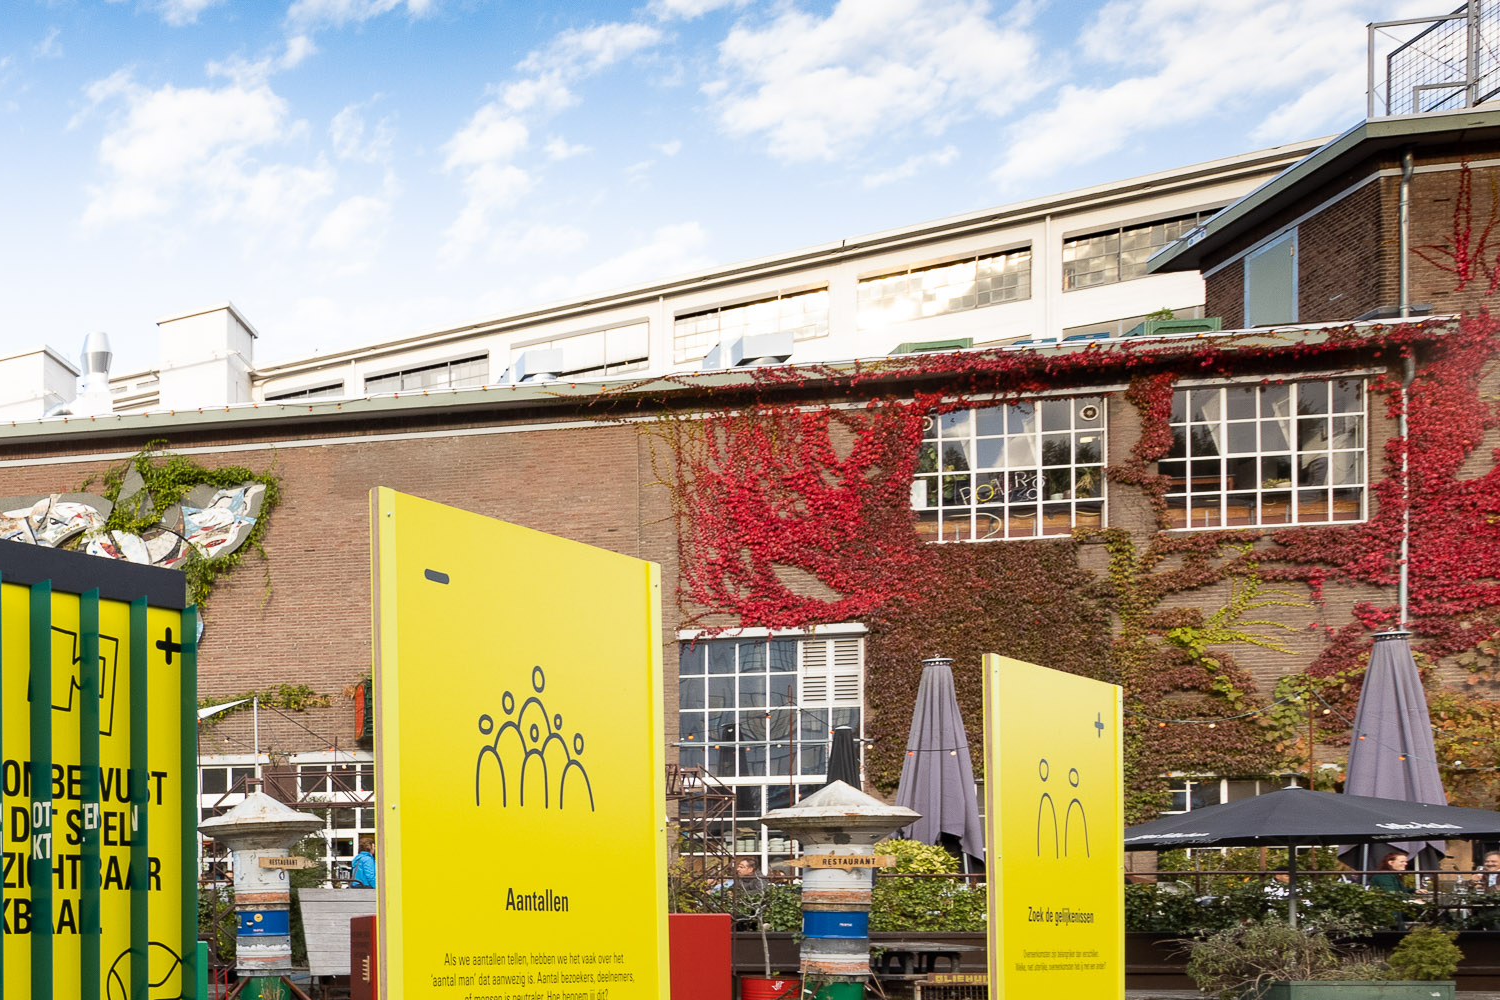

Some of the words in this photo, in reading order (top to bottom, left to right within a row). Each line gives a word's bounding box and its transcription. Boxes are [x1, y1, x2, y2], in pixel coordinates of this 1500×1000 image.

[505, 887, 568, 912] Aantallen
[443, 953, 456, 966] Als
[457, 955, 470, 965] we
[472, 952, 505, 965] aantallen
[506, 952, 528, 966] tellen,
[529, 952, 555, 965] hebben
[556, 955, 567, 964] we
[569, 952, 580, 964] het
[581, 951, 596, 964] vaak
[597, 954, 612, 964] over
[613, 951, 624, 963] het
[478, 972, 490, 985] dat
[492, 971, 525, 987] aanwezig
[527, 971, 535, 984] is.
[536, 971, 559, 984] Aantal
[560, 970, 595, 984] bezoekers,
[596, 970, 635, 984] deelnemers,
[596, 988, 608, 1000] dit?
